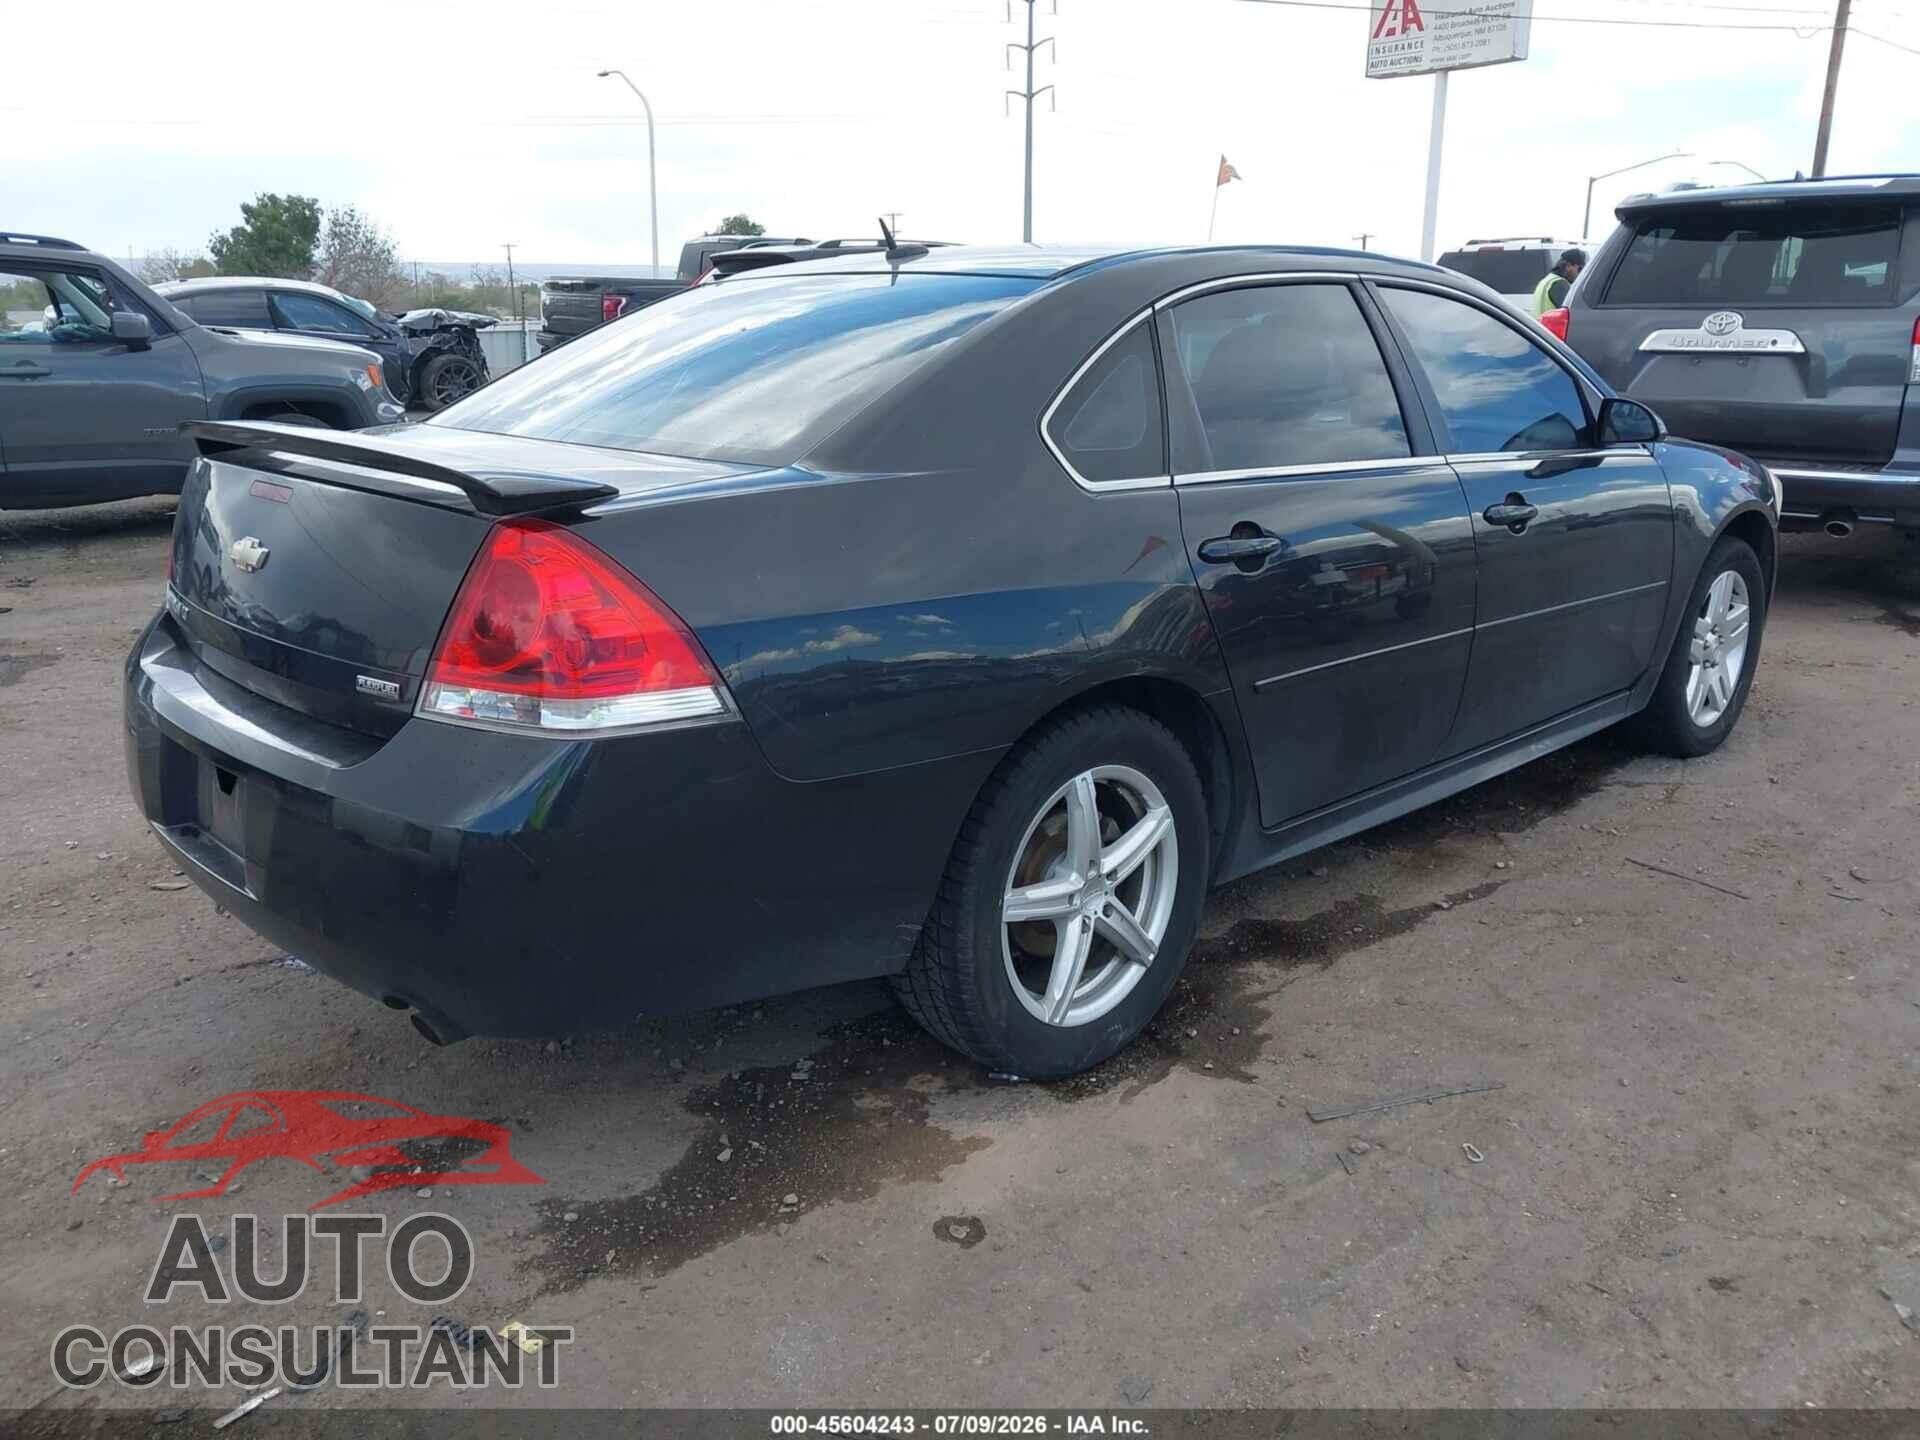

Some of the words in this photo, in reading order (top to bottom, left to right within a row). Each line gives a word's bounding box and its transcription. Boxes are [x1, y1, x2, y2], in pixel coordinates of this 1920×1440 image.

[1485, 2, 1515, 12] Auctions
[1370, 40, 1424, 56] INSURANCE
[1370, 59, 1389, 69] AUTO
[1389, 56, 1423, 67] AUCTIONS
